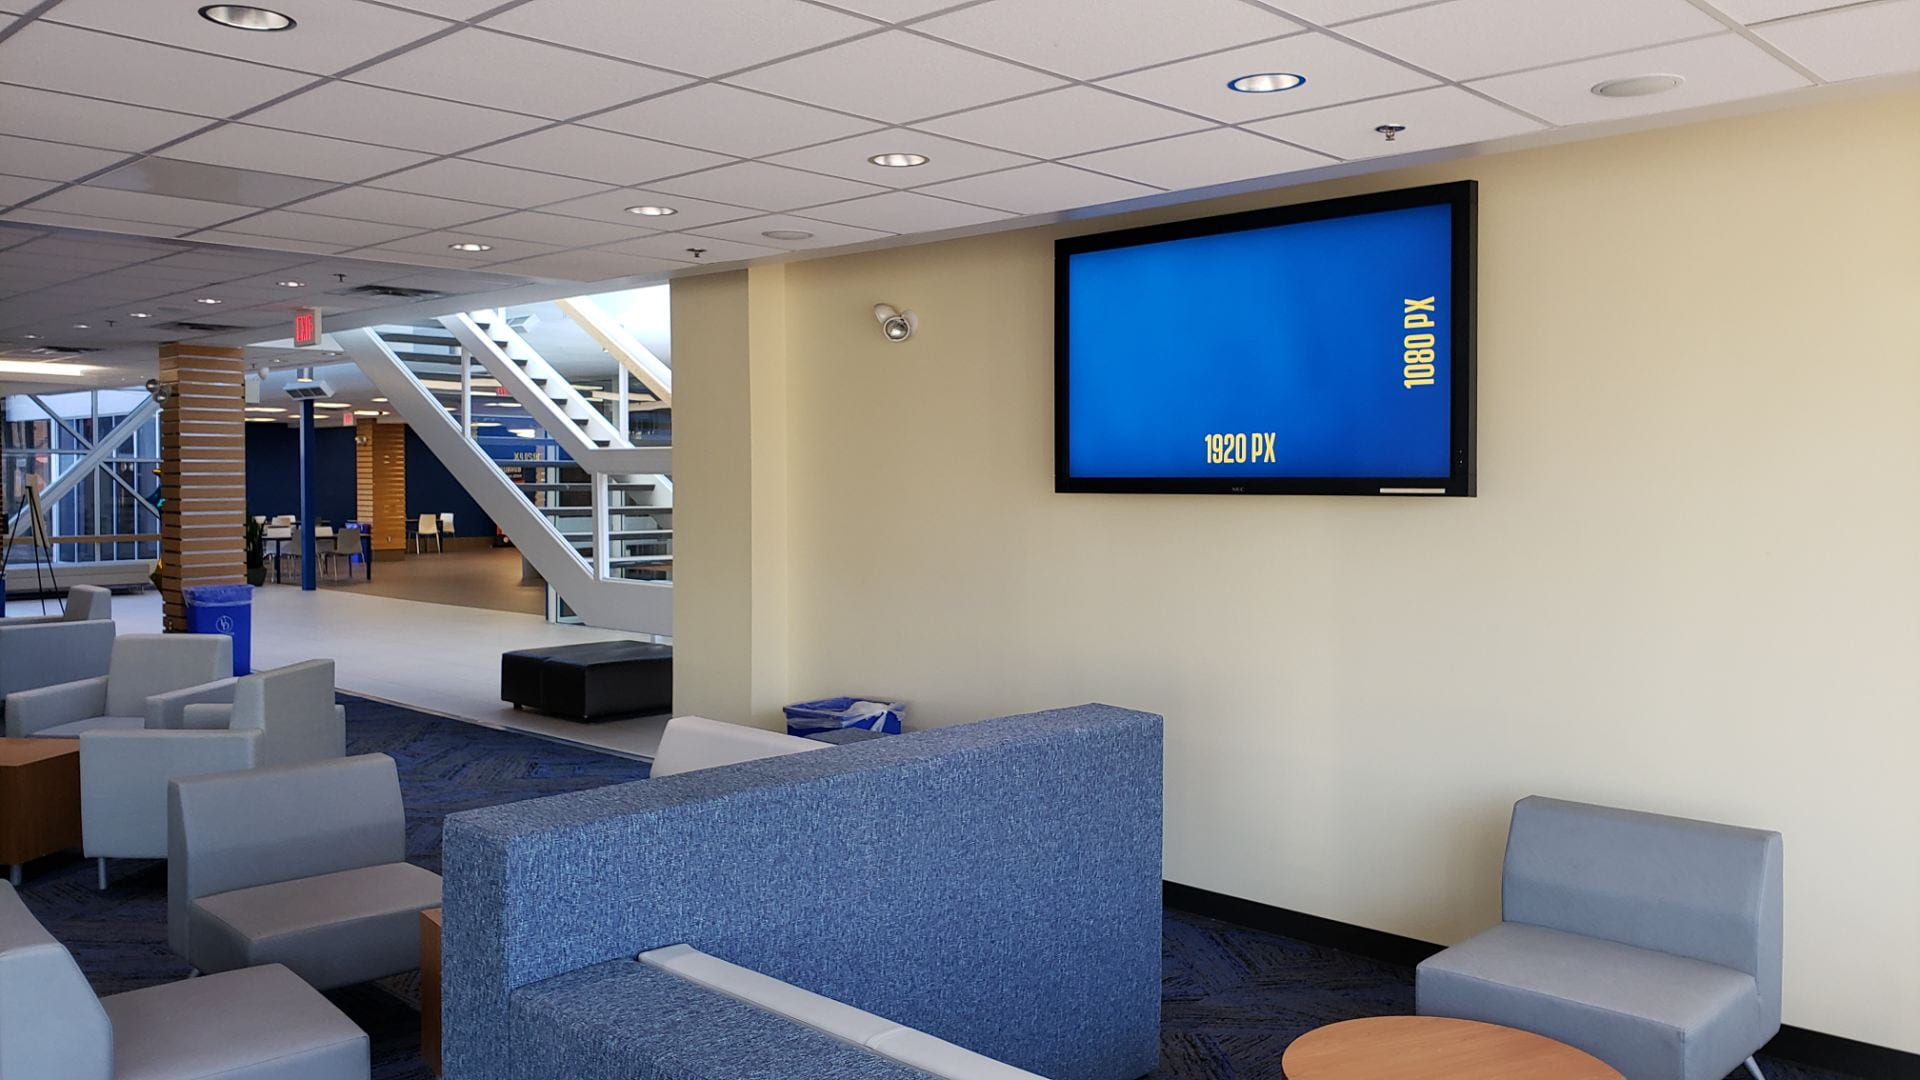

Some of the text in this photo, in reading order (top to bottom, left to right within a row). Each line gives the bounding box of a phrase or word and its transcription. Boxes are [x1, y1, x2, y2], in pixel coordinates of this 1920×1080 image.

[1404, 296, 1435, 389] 1080 PX
[1204, 432, 1276, 464] 1920 PX
